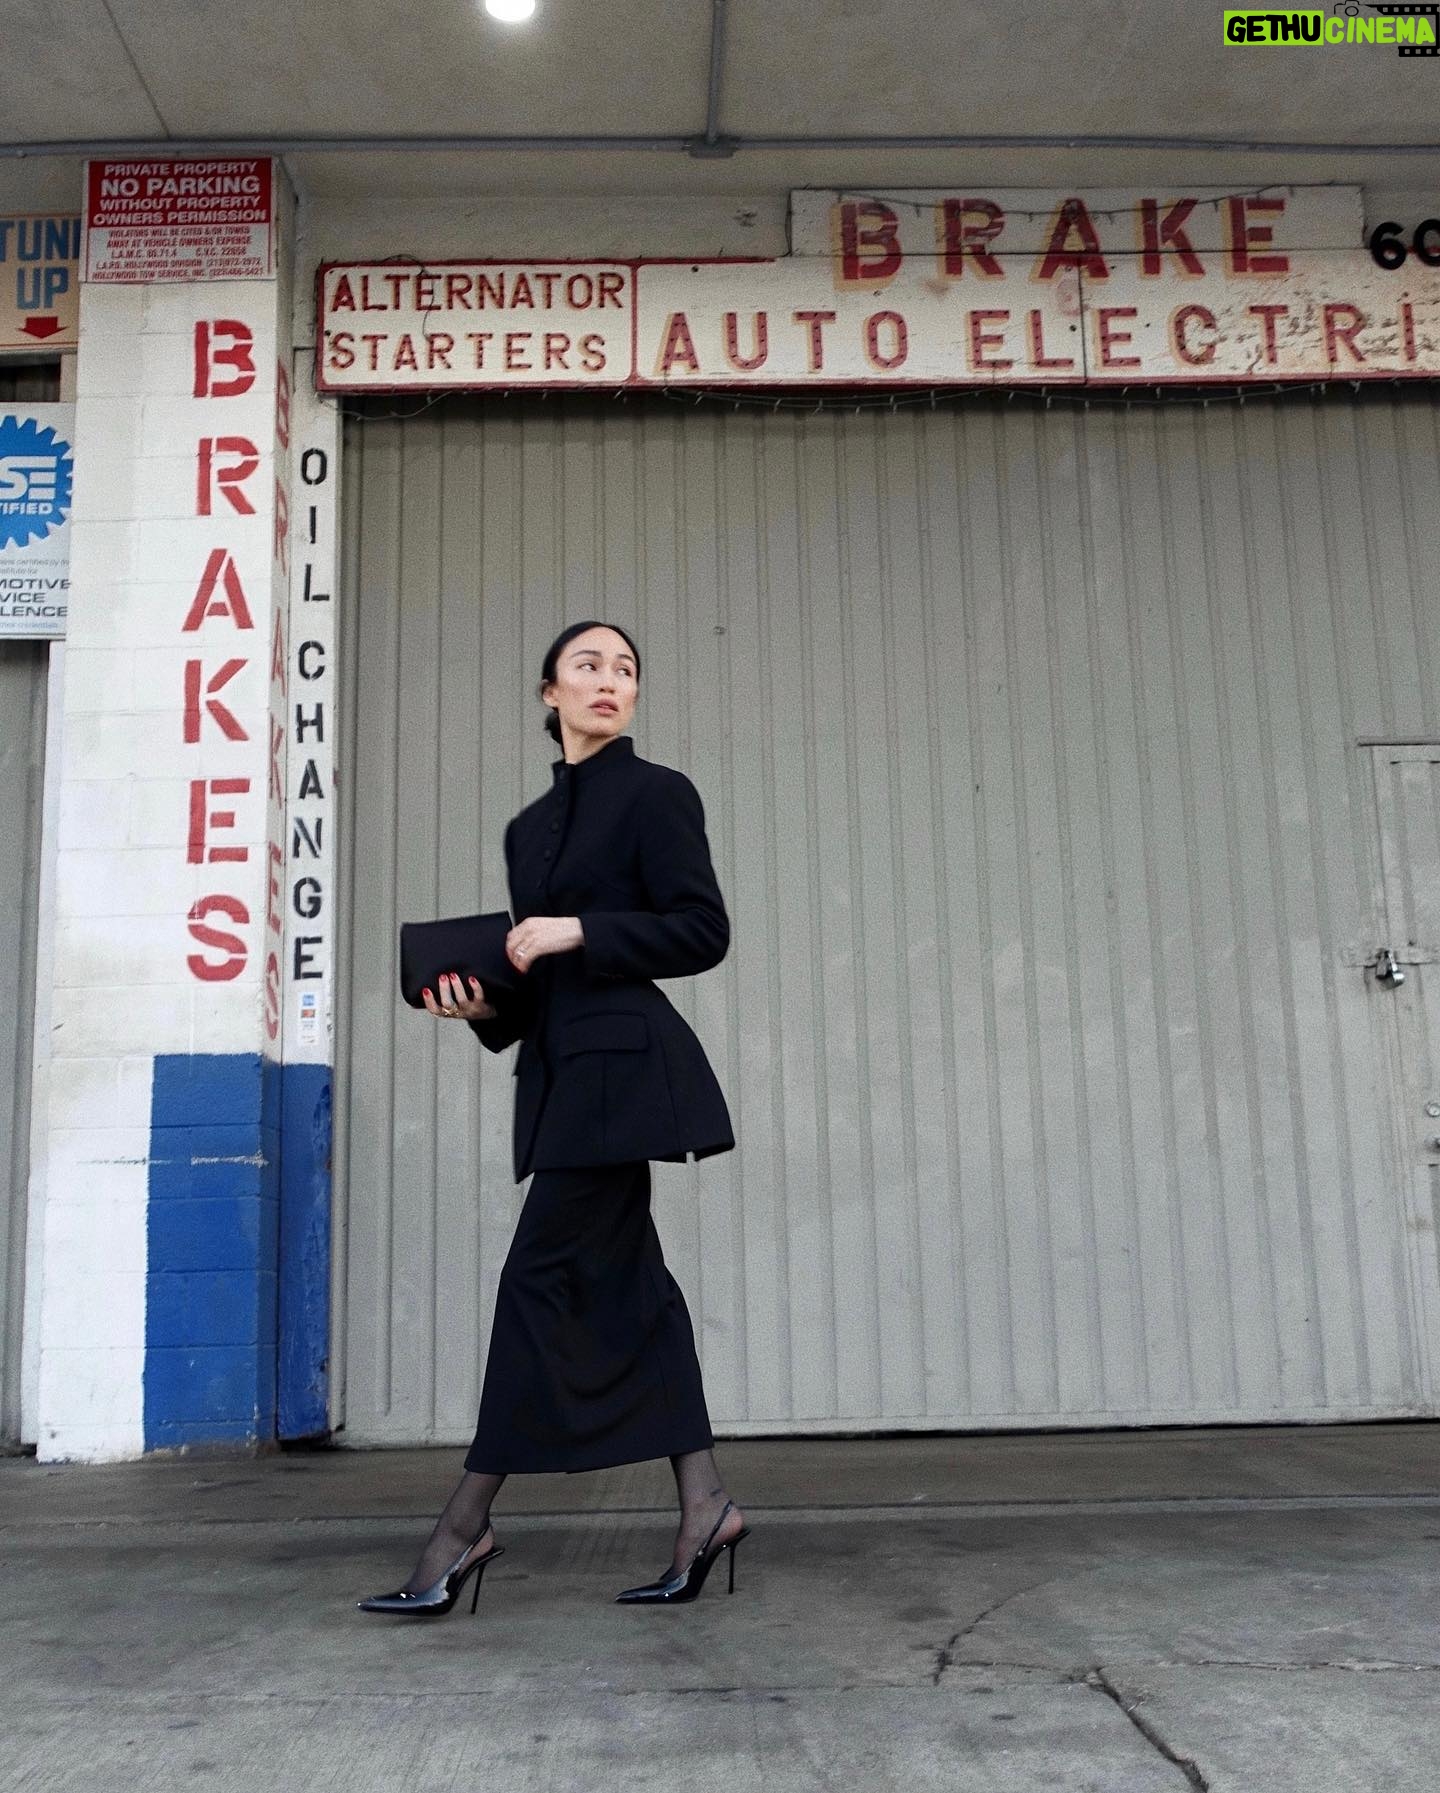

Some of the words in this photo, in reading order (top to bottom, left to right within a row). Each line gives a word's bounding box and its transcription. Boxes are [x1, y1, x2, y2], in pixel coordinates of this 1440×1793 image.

[101, 179, 139, 197] NO
[146, 175, 260, 195] PARKING
[104, 164, 169, 176] PRIVATE
[174, 162, 257, 174] PROPERTY
[93, 213, 163, 226] OWNERS
[167, 209, 266, 223] PERMISSION
[100, 199, 172, 211] WITHOUT
[176, 196, 260, 209] PROPERTY
[0, 219, 81, 262] TUN
[107, 240, 130, 249] AWAY
[143, 238, 177, 248] VEHICLE
[179, 237, 213, 247] OWNERS
[216, 236, 252, 246] EXPENSE
[831, 199, 1289, 288] BRAKE
[16, 266, 69, 310] UP
[330, 272, 625, 313] ALTERNATOR
[330, 332, 607, 373] STARTERS
[655, 309, 908, 382] AUTO
[299, 448, 330, 602] OIL
[183, 319, 257, 982] BRAKES
[292, 640, 325, 981] CHANGE
